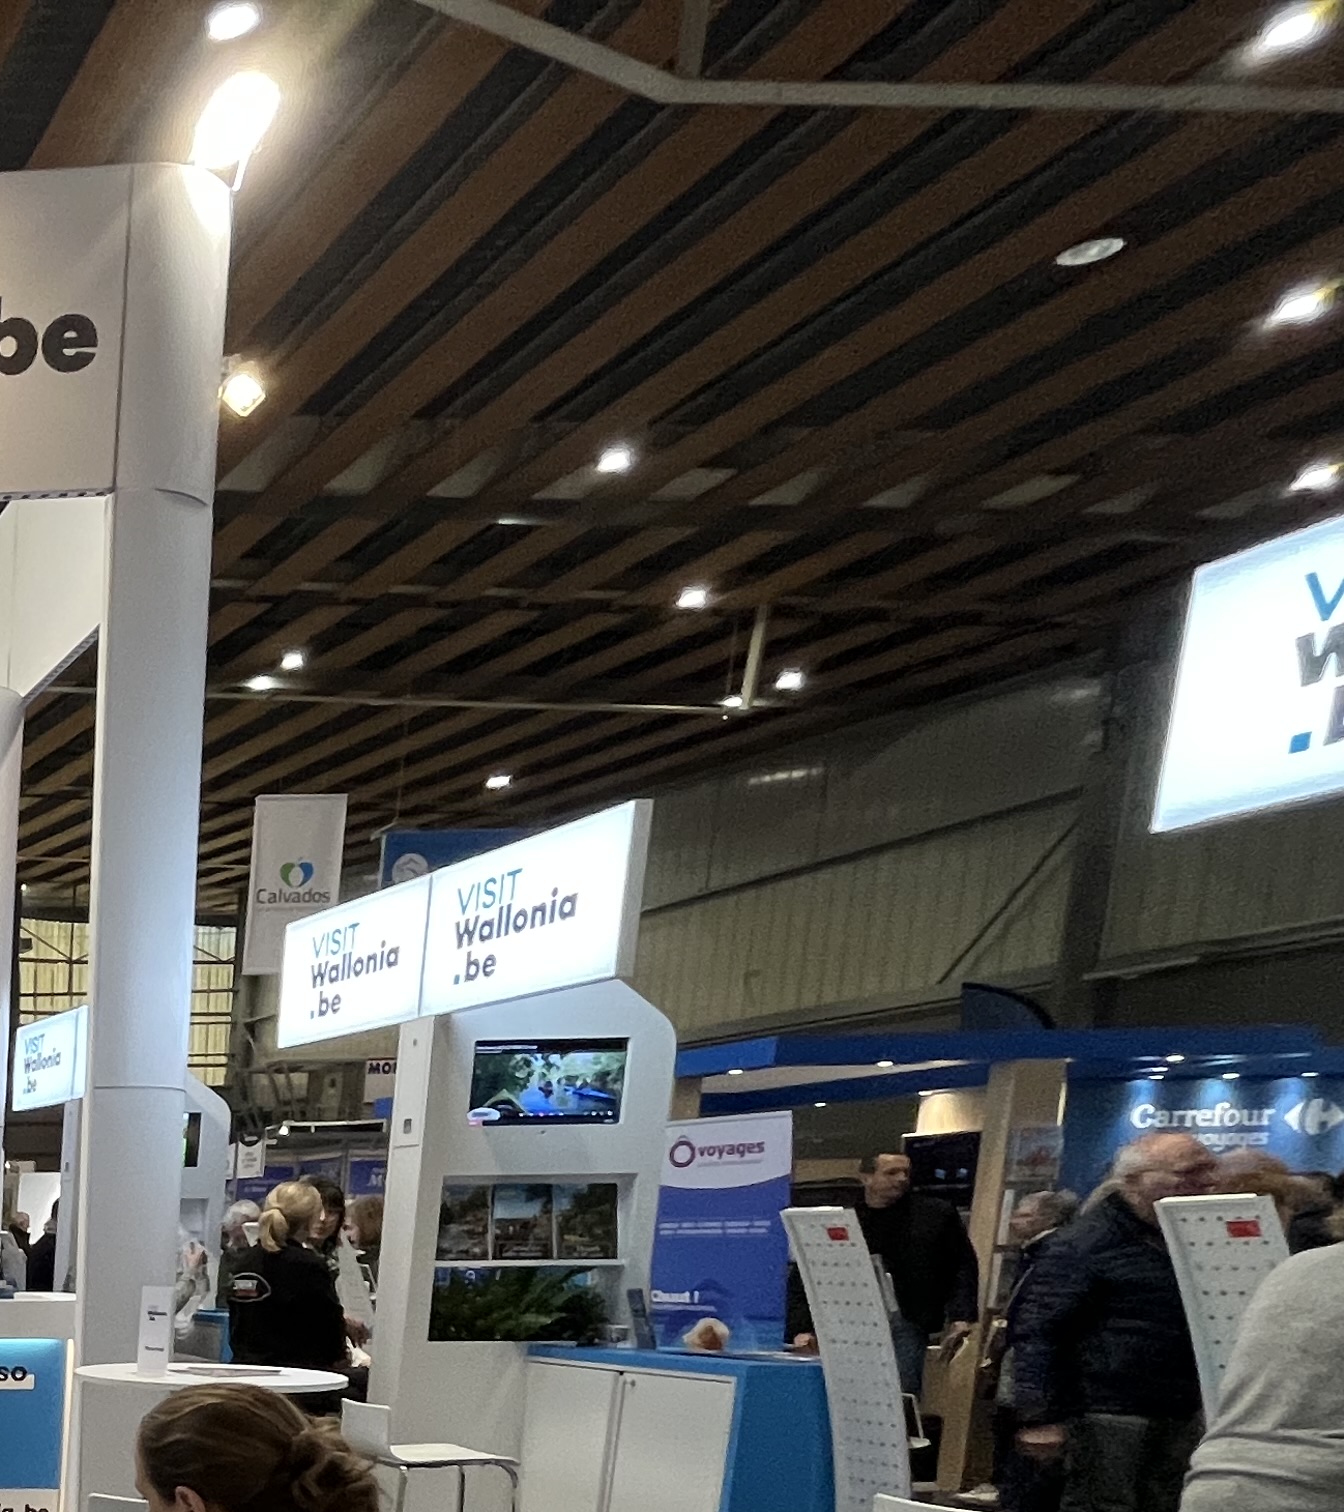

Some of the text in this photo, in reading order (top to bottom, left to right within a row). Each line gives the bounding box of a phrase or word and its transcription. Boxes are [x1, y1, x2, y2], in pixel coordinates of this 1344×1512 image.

[256, 888, 331, 903] Calvados
[458, 868, 523, 915] VISIT
[456, 887, 578, 949] Wallonia
[312, 922, 360, 958] VISIT
[311, 940, 400, 988] Wallonia
[1130, 1103, 1276, 1128] Carrefour
